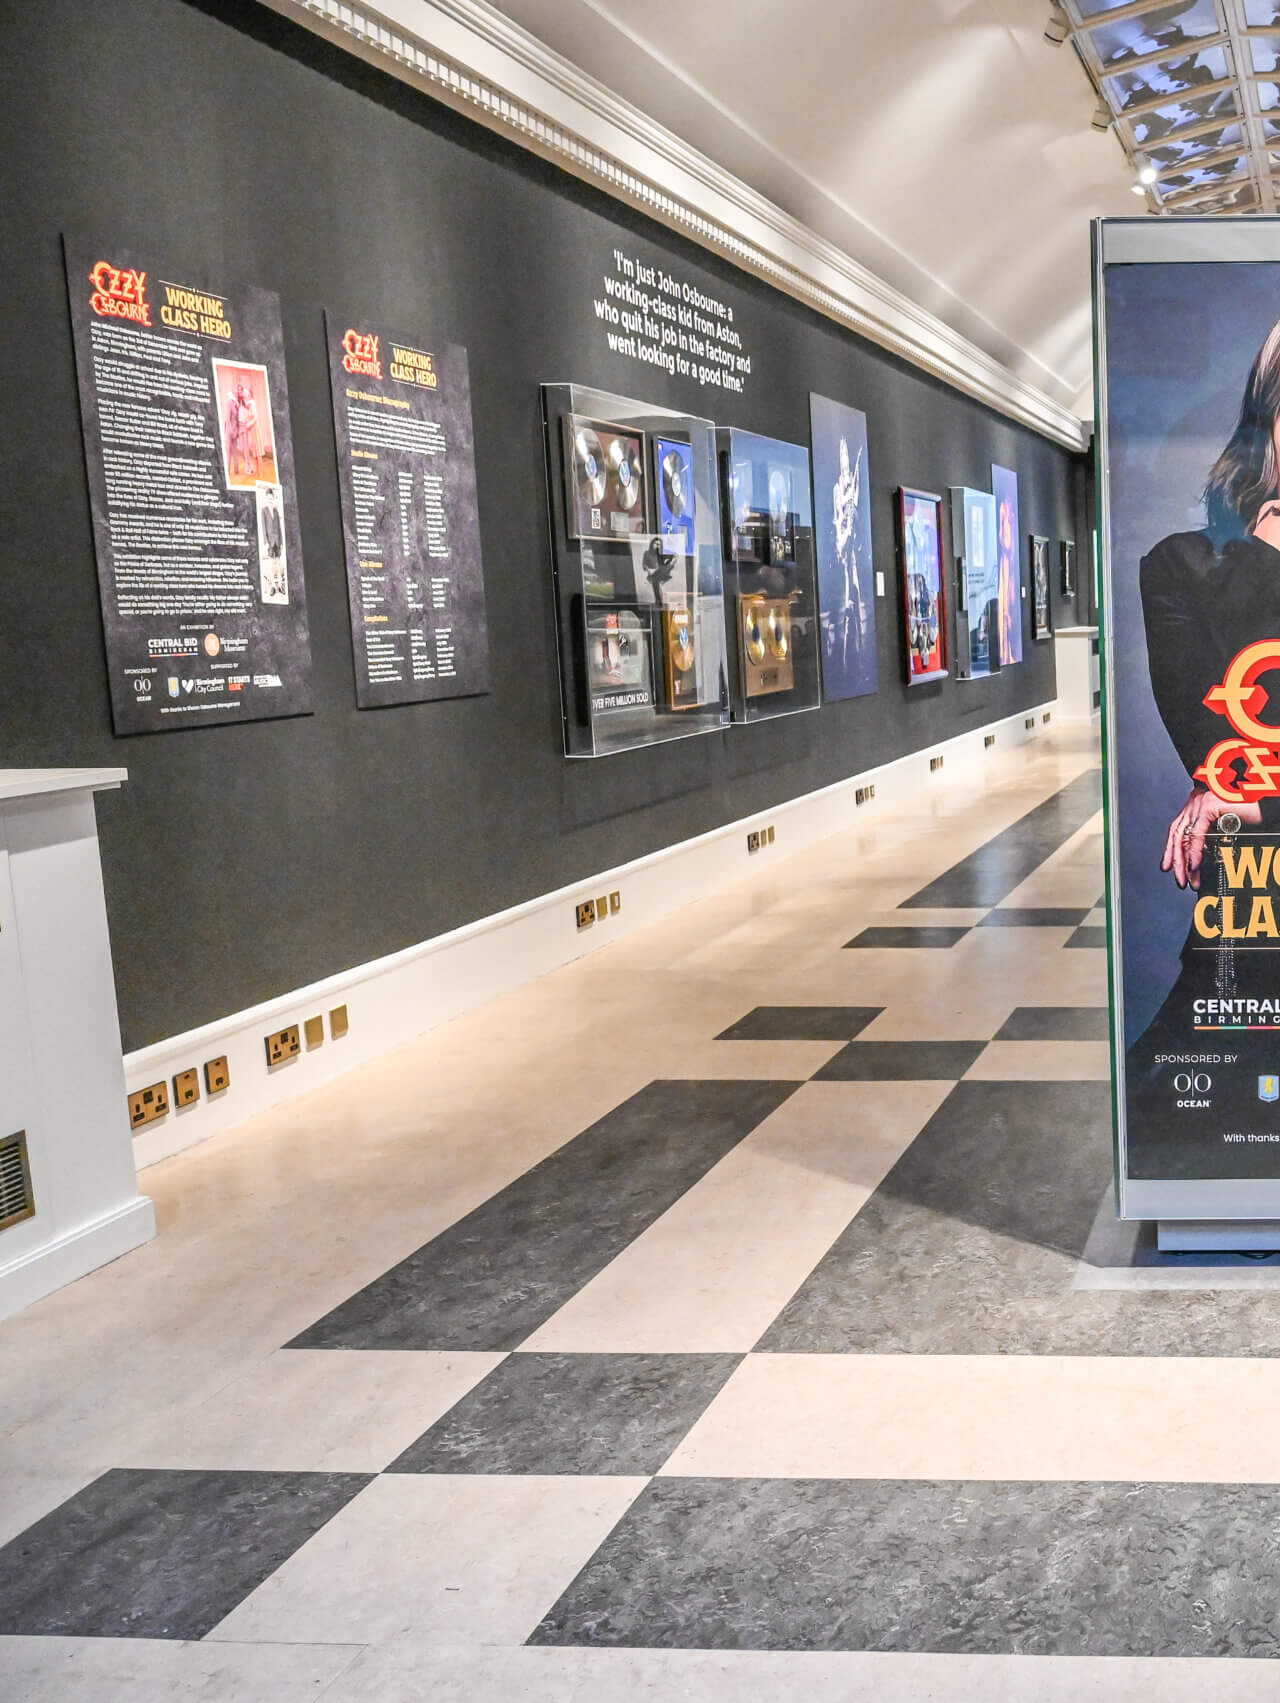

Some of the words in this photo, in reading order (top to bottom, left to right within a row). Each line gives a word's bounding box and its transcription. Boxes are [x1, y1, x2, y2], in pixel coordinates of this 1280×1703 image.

[89, 261, 148, 305] OZZY
[635, 259, 656, 287] just
[658, 271, 681, 299] John
[682, 283, 727, 319] Osbourne:
[727, 307, 733, 322] a
[89, 293, 152, 326] OSBOURNE
[165, 287, 224, 318] WORKING
[604, 276, 677, 322] working-class
[678, 304, 692, 328] kid
[694, 314, 714, 337] from
[716, 321, 742, 350] Aston,
[160, 306, 198, 331] CLASS
[200, 316, 232, 339] HERO
[593, 299, 619, 324] who
[621, 310, 643, 334] quit
[644, 315, 659, 339] his
[660, 322, 677, 347] job
[678, 330, 688, 351] in
[689, 333, 705, 355] the
[705, 339, 735, 371] factory
[736, 356, 751, 374] and
[393, 347, 432, 369] WORKING
[607, 332, 636, 358] went
[638, 338, 675, 375] looking
[676, 353, 690, 375] for
[691, 362, 698, 378] a
[699, 365, 721, 386] good
[390, 362, 415, 383] CLASS
[415, 370, 437, 388] HERO
[148, 638, 183, 648] CENTRAL
[605, 697, 615, 707] FIVE
[616, 695, 636, 705] MILLION
[636, 692, 648, 703] SOLD
[1155, 1054, 1221, 1063] SPONSORED
[1224, 1054, 1238, 1063] BY
[1223, 1133, 1245, 1142] With
[1247, 1132, 1279, 1142] thanks
